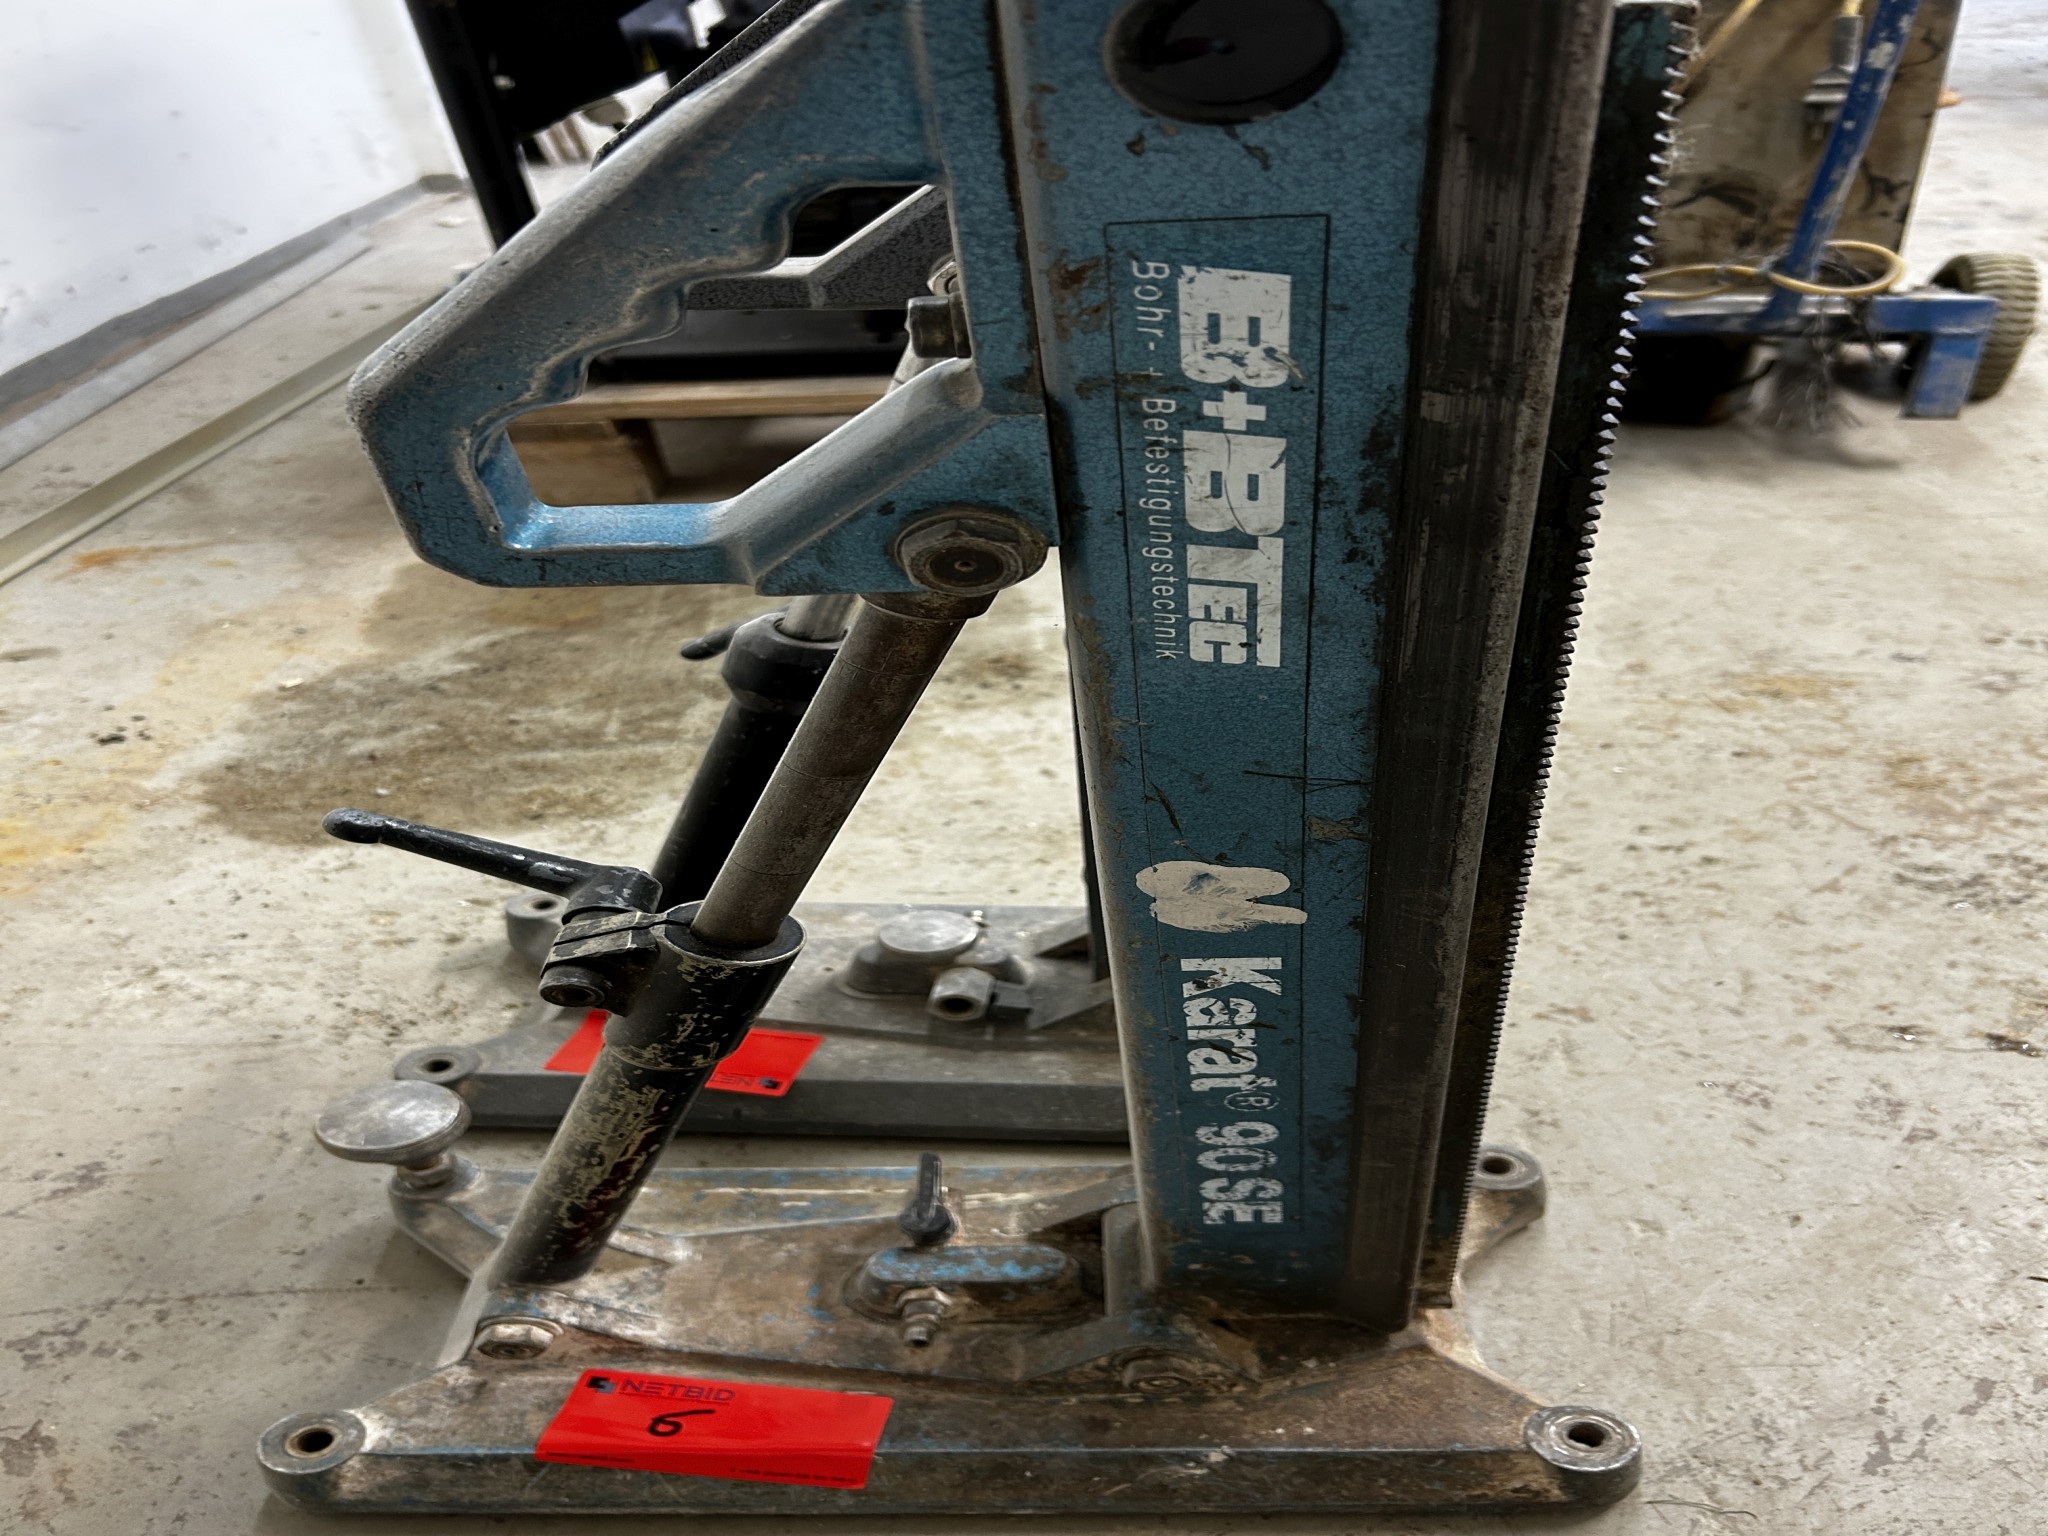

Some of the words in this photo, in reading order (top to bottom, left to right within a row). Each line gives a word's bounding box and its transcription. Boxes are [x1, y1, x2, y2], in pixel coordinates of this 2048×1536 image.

[1139, 397, 1184, 660] Befestigungstechnik
[620, 1379, 736, 1403] NETBID
[647, 1408, 716, 1437] 6
